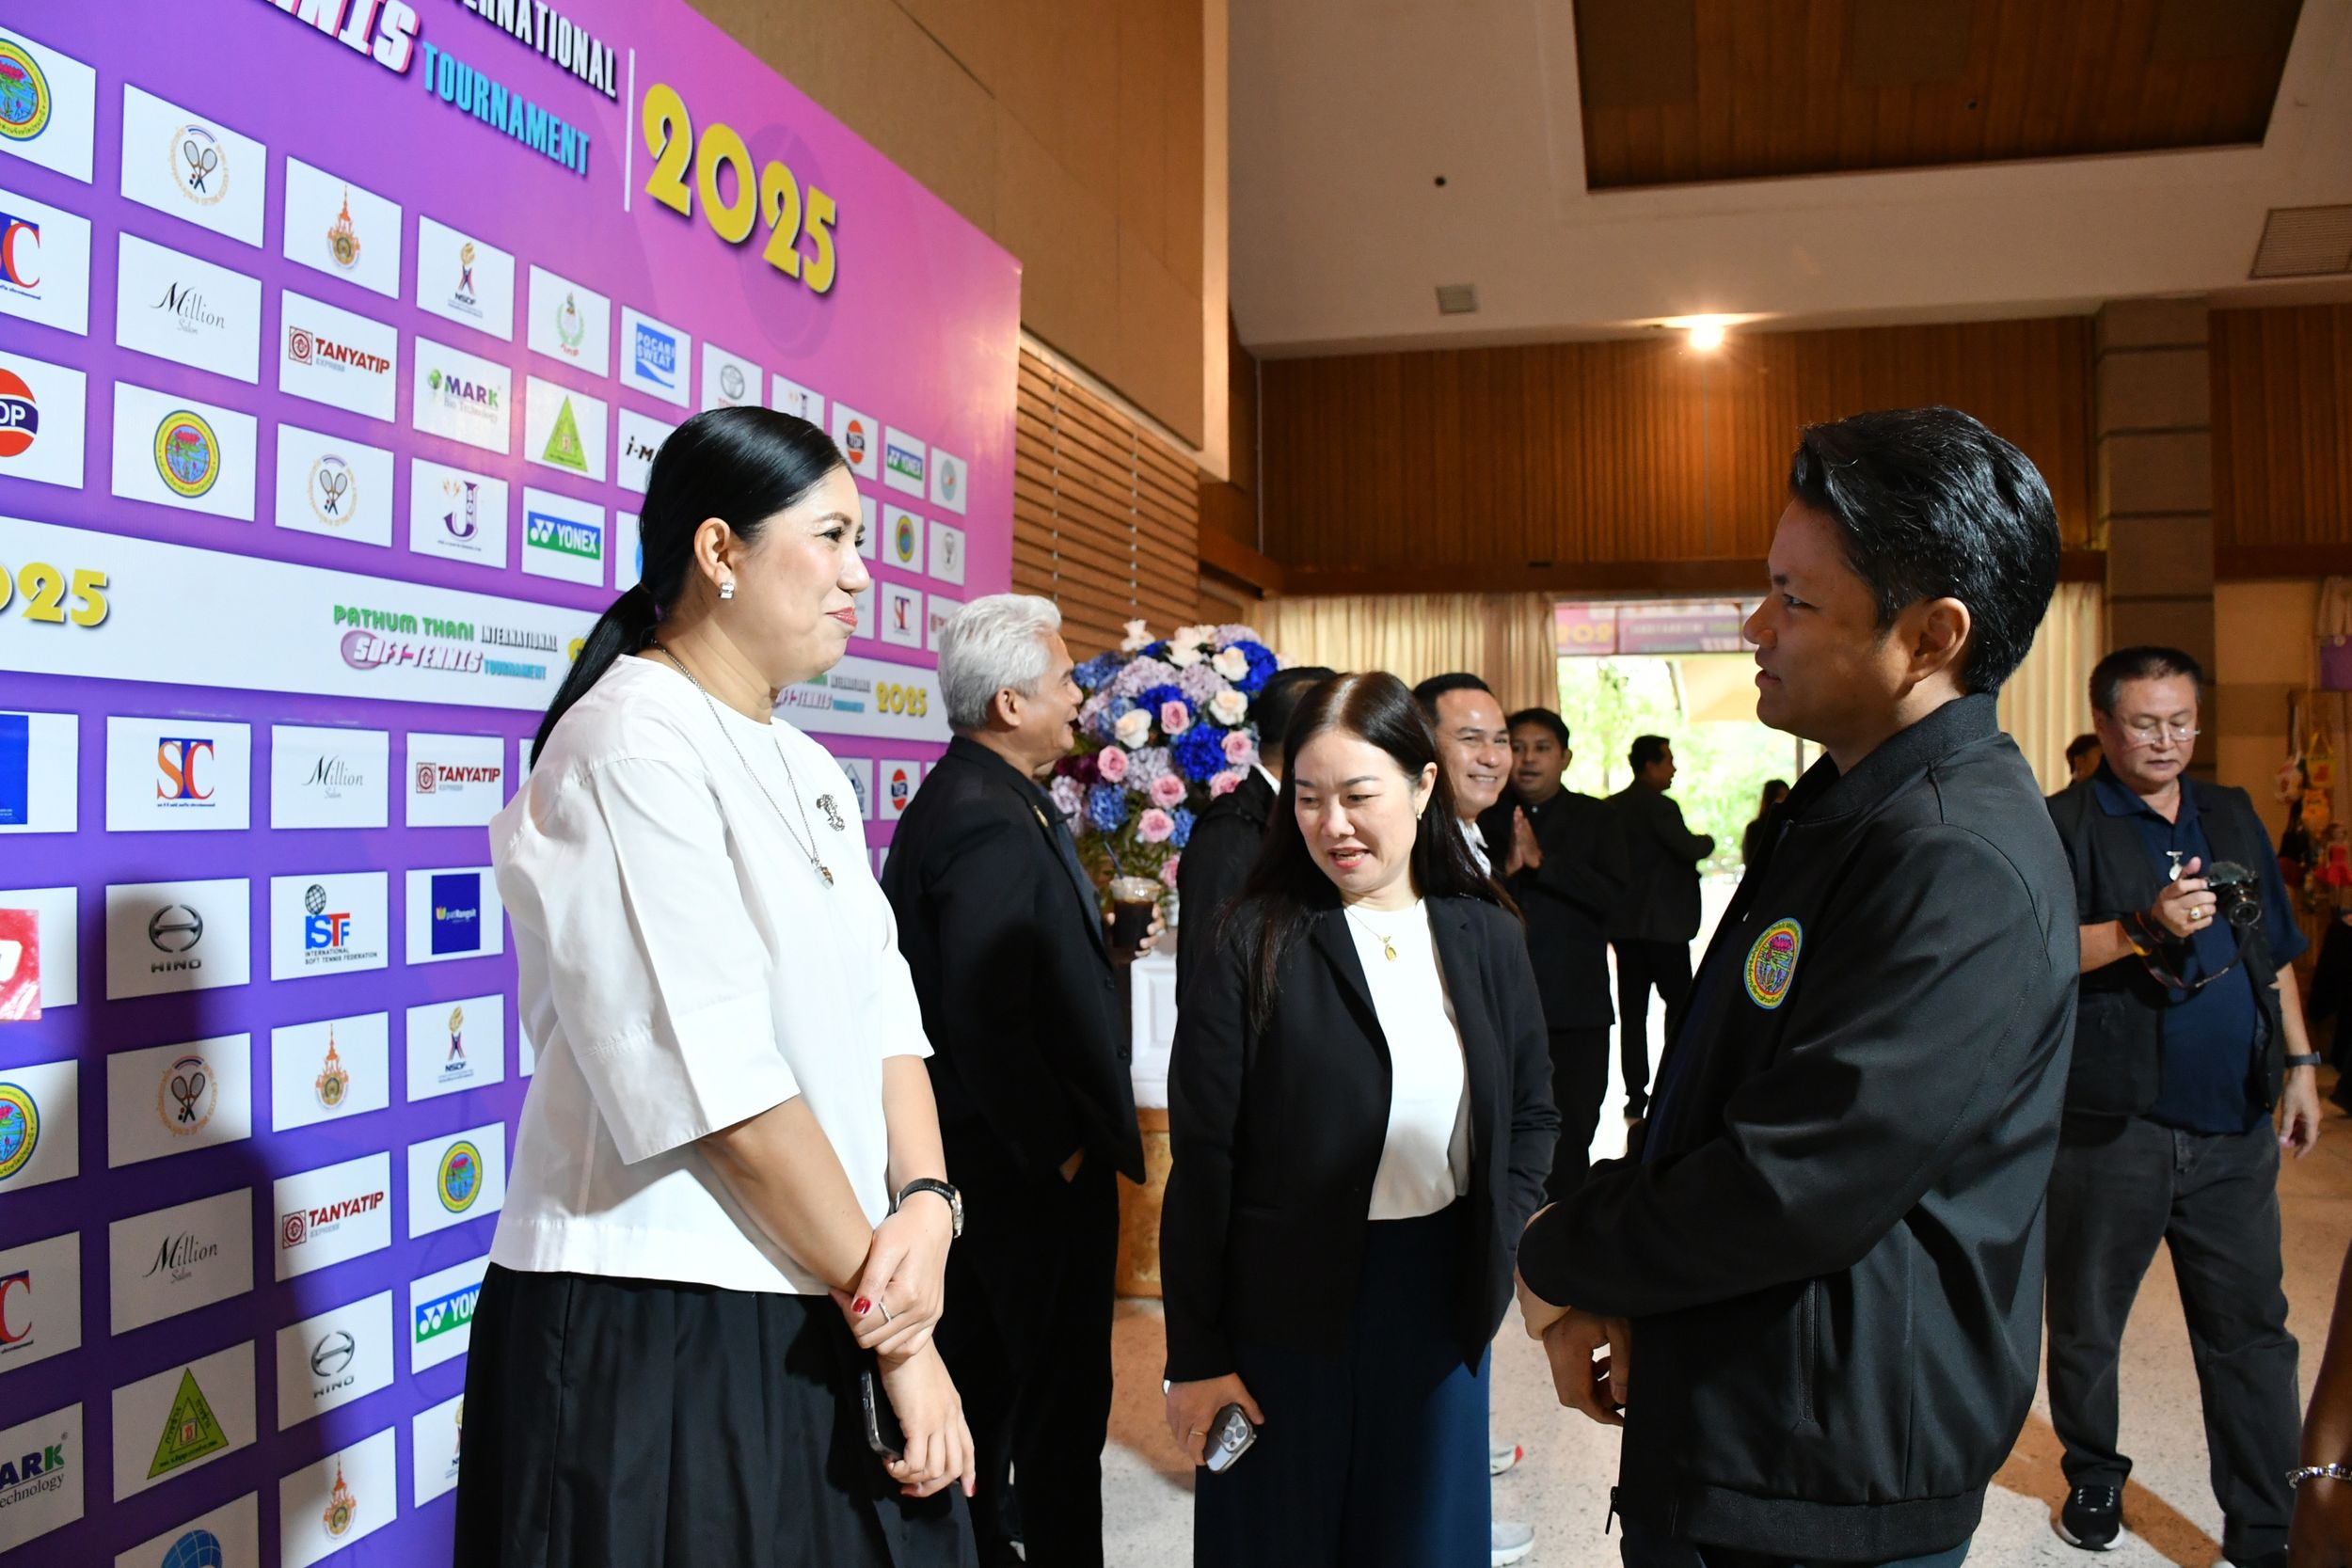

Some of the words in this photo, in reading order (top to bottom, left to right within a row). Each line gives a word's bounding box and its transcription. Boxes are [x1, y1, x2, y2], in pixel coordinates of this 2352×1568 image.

[422, 41, 590, 176] TOURNAMENT
[643, 83, 835, 293] 2025
[150, 281, 225, 329] Million
[316, 337, 389, 373] TANYATIP
[445, 374, 498, 407] MARK
[556, 523, 597, 554] YONEX
[0, 562, 108, 627] 25
[333, 605, 418, 634] PATHUM
[422, 617, 474, 641] THANI
[481, 625, 558, 653] INTERNATIONAL
[484, 658, 548, 680] TOURNAMENT
[876, 680, 928, 718] 2025
[301, 754, 364, 786] Million
[438, 767, 501, 783] TANYATIP
[305, 912, 350, 949] ISTF
[151, 958, 202, 974] HINO
[305, 948, 349, 957] INTERNATIONAL
[322, 955, 342, 963] TENNIS
[344, 951, 378, 960] FEDERATION
[309, 1191, 384, 1227] TANYATIP
[143, 1230, 219, 1278] Million
[313, 1375, 355, 1399] HINO
